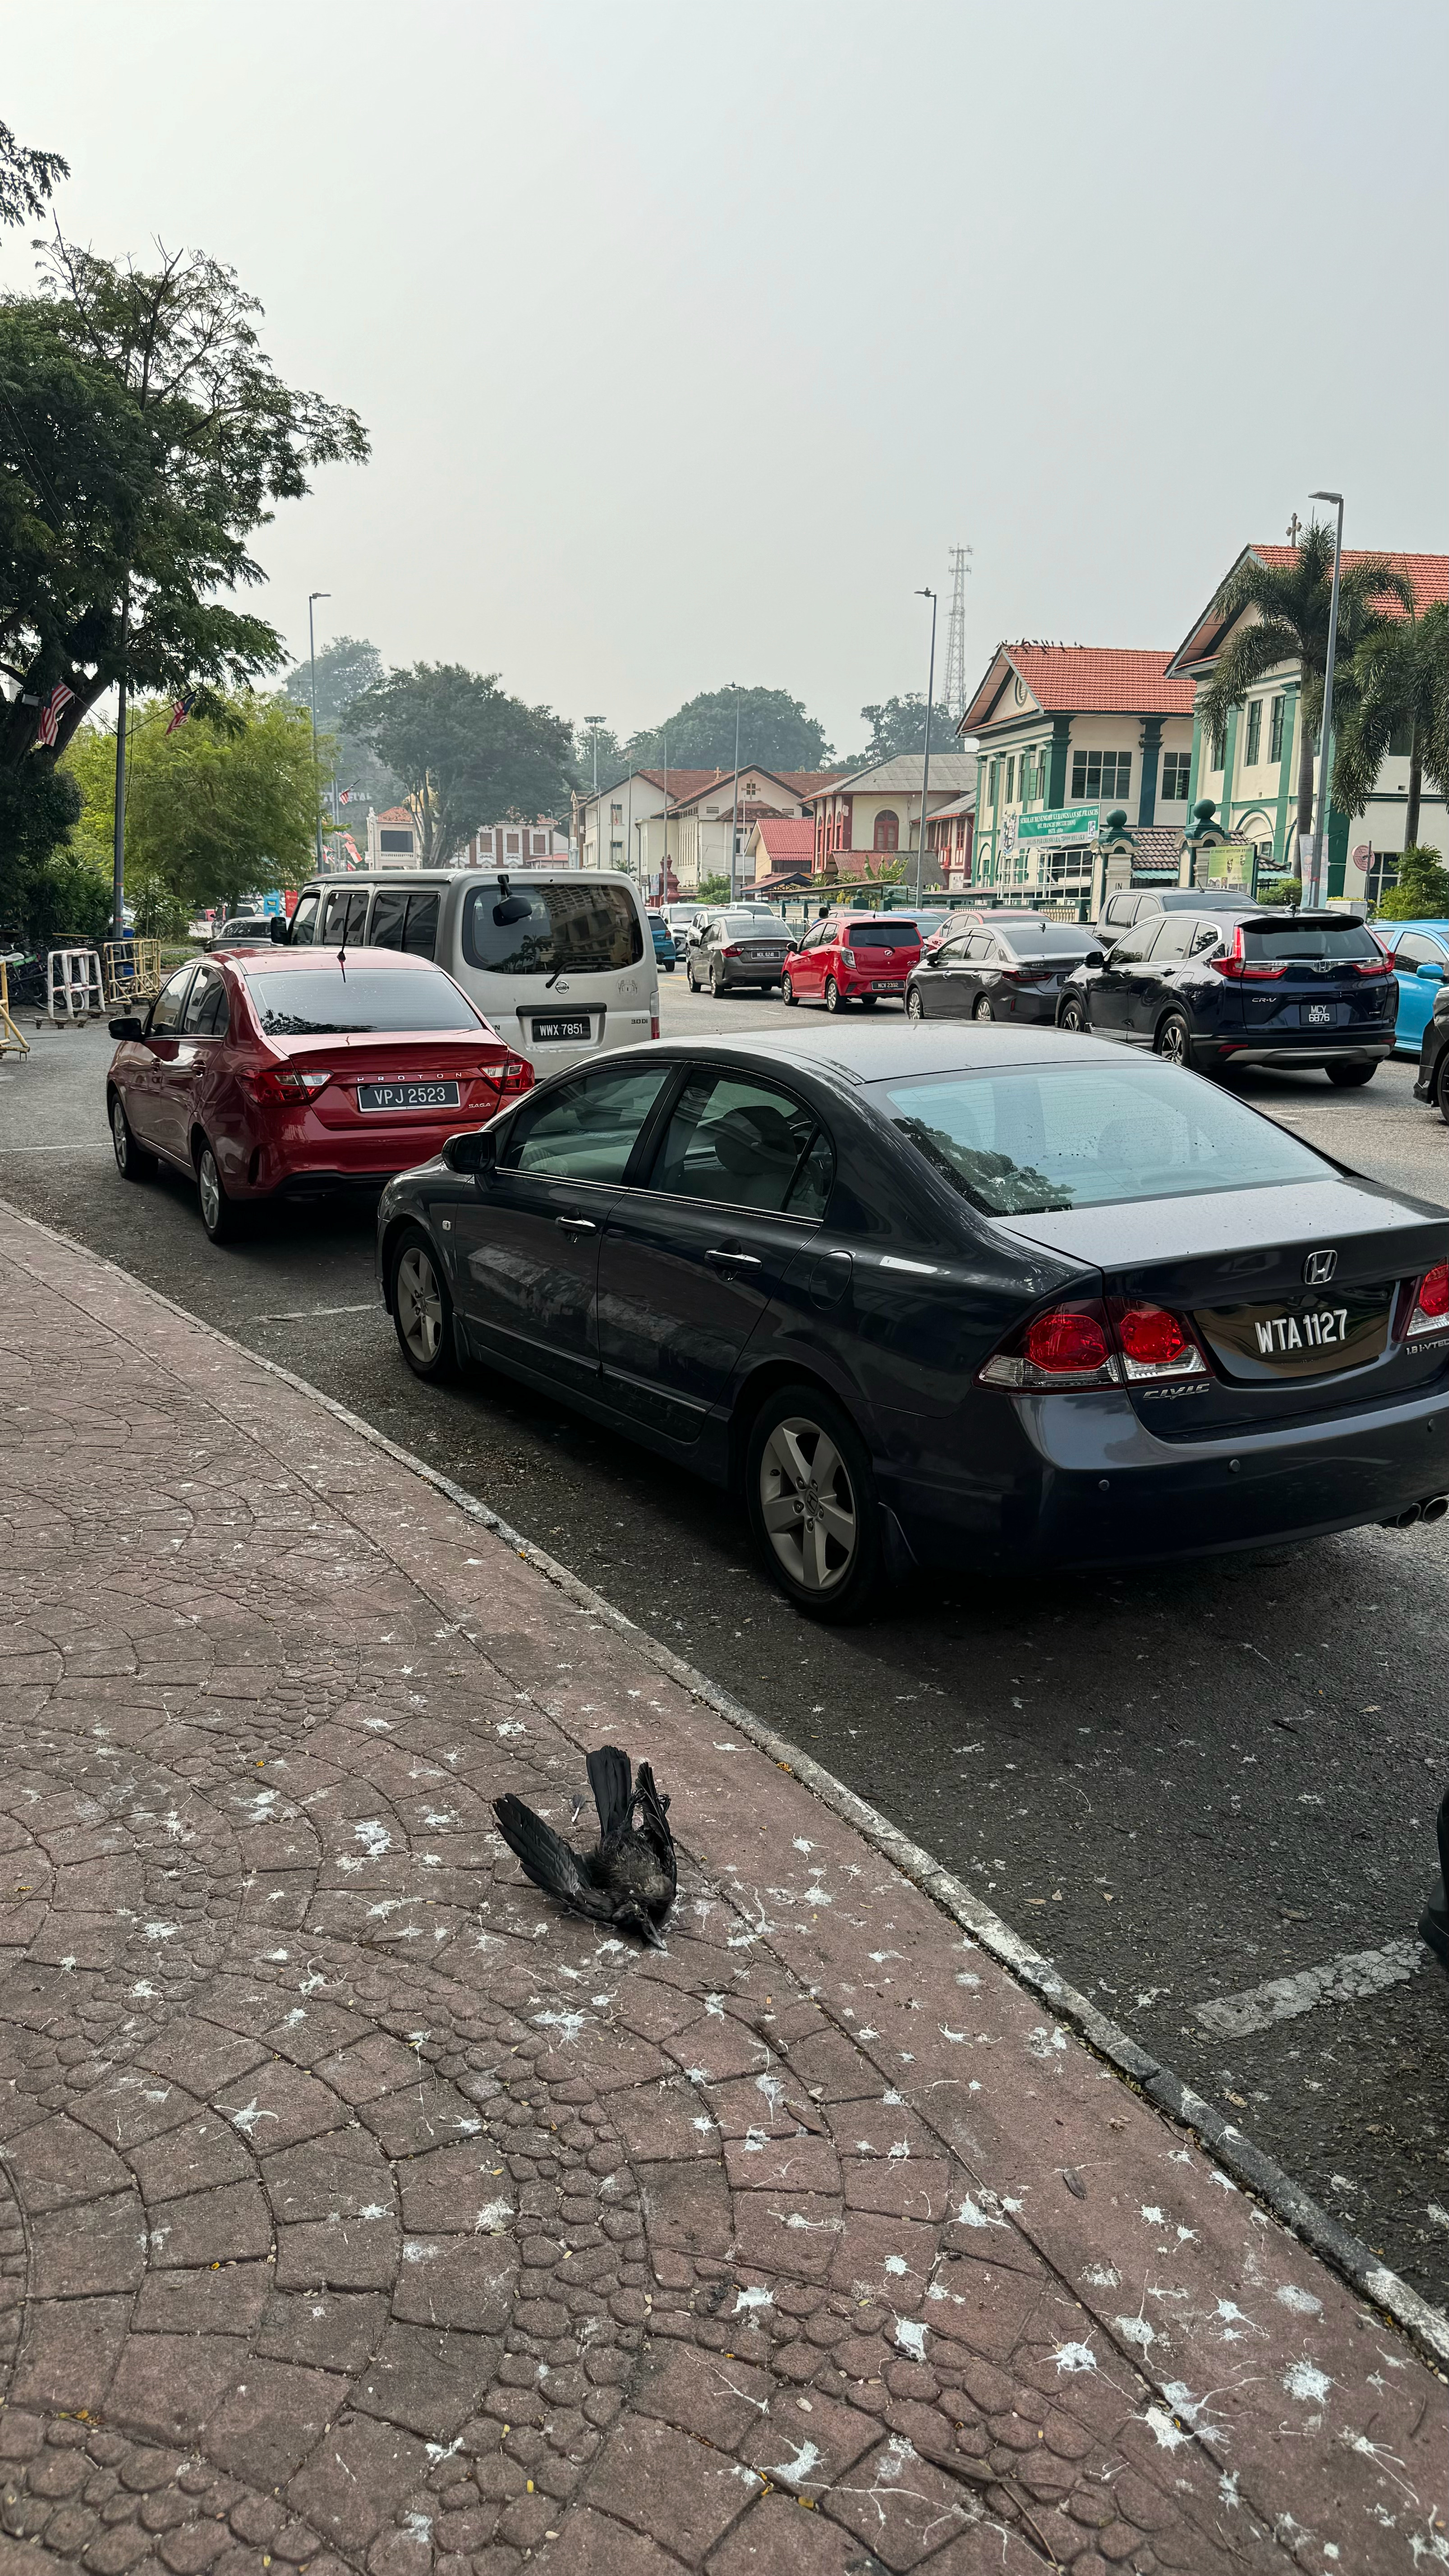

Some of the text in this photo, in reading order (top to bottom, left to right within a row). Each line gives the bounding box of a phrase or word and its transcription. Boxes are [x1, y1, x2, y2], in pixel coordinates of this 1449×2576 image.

[1311, 1005, 1326, 1014] MCY
[1309, 1013, 1329, 1022] 6876
[540, 1023, 583, 1036] WWX 7851
[357, 1072, 461, 1081] PROTON
[374, 1087, 446, 1104] VPJ 2523
[1143, 1383, 1210, 1400] CIVIC
